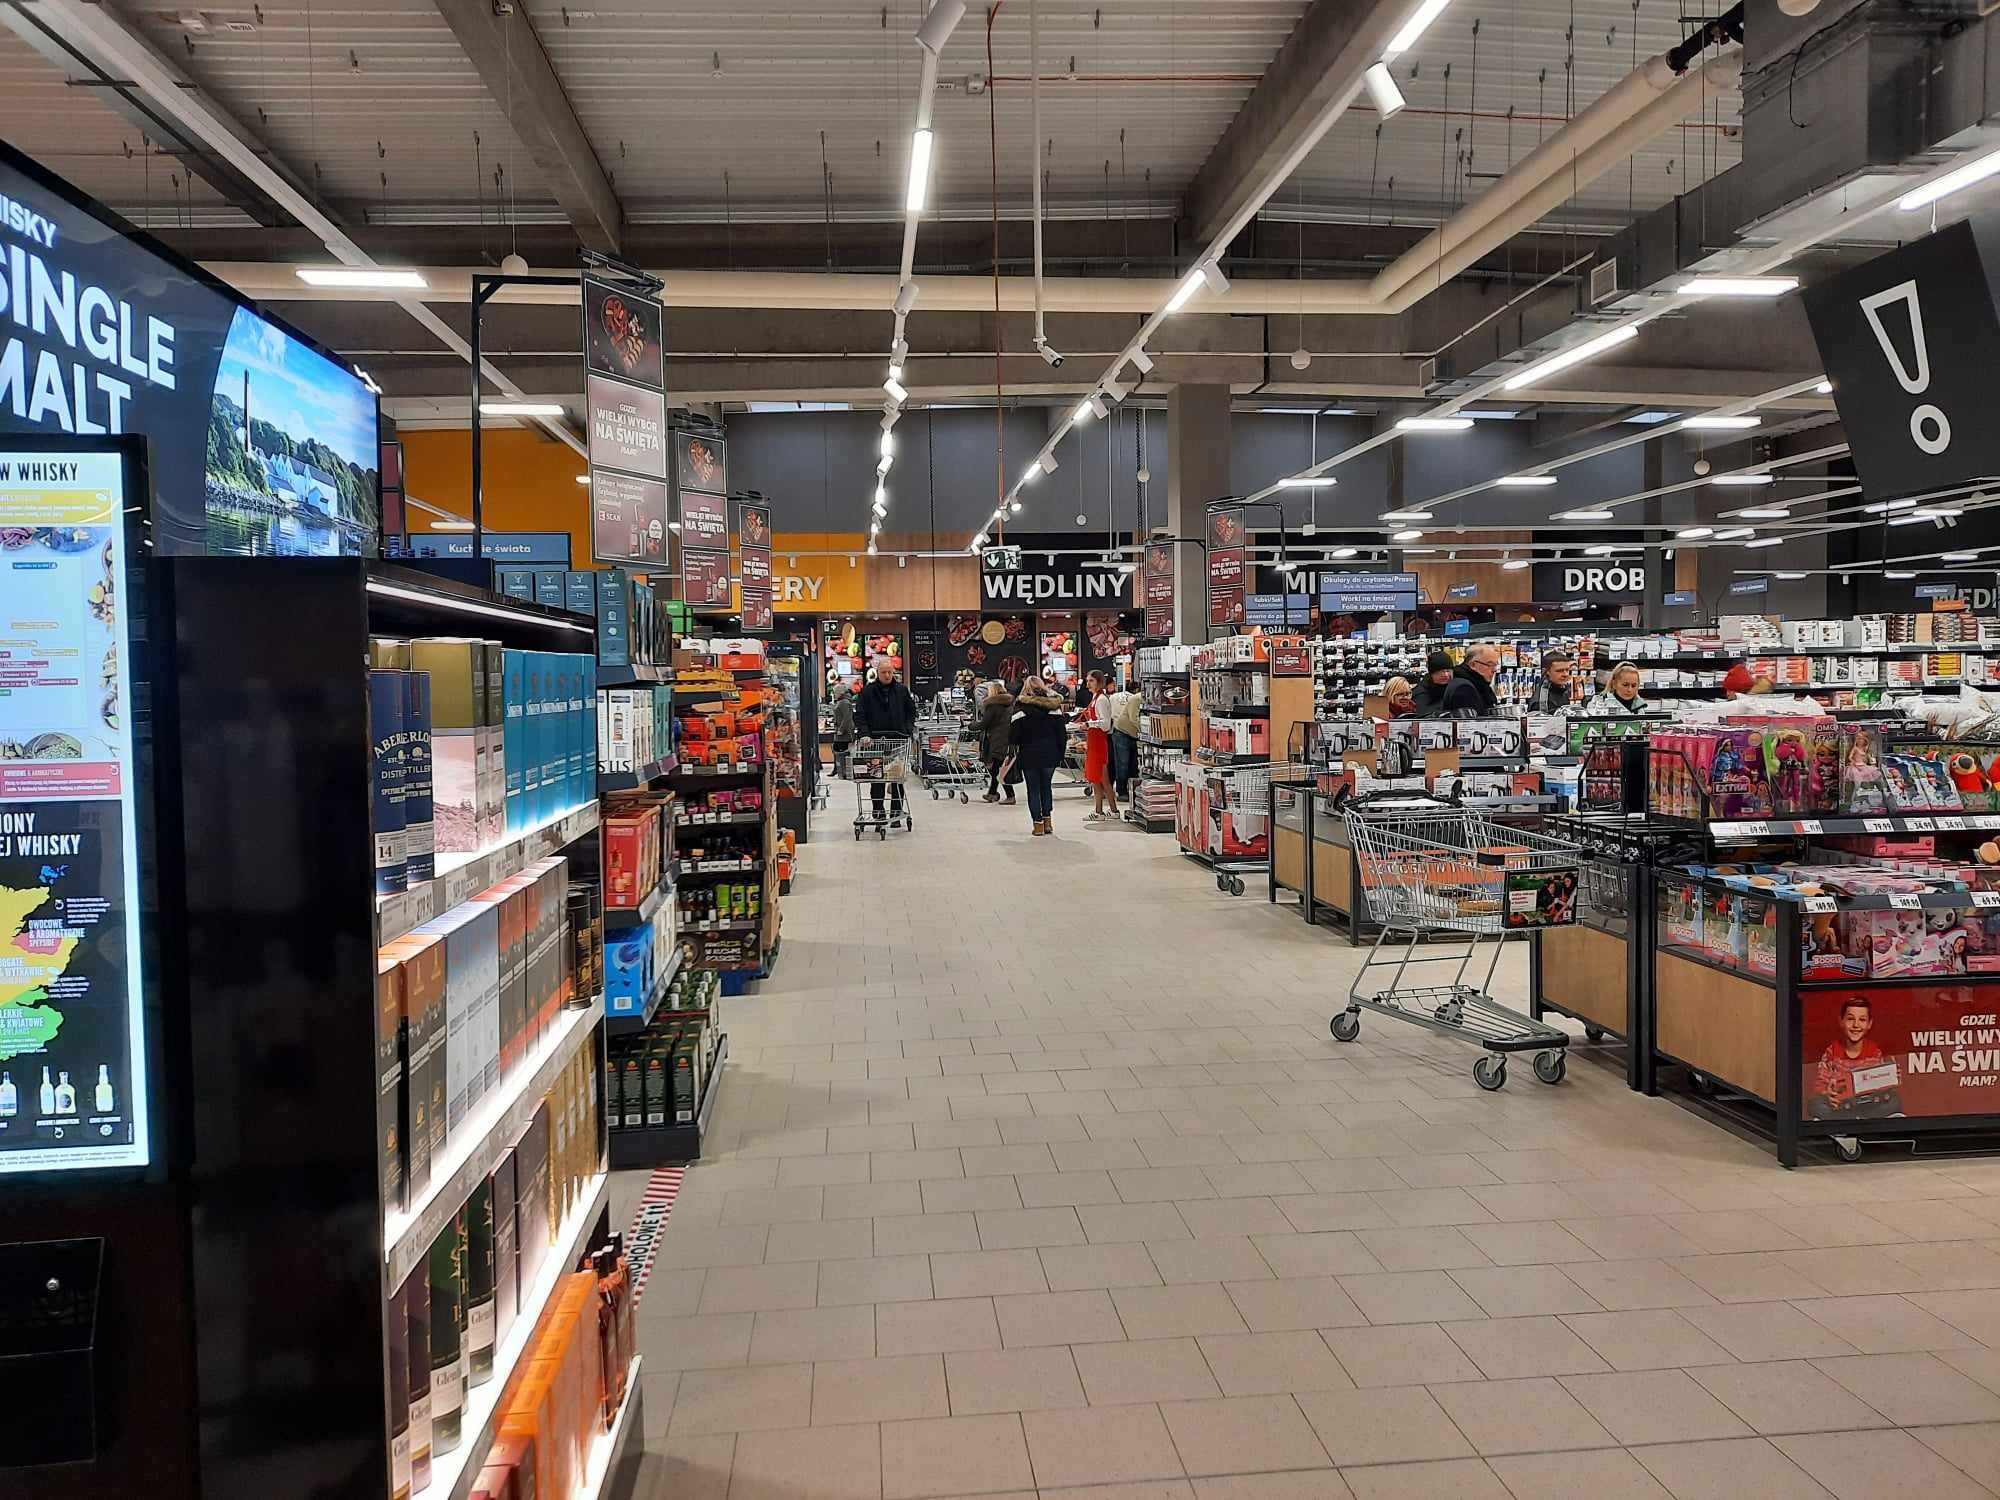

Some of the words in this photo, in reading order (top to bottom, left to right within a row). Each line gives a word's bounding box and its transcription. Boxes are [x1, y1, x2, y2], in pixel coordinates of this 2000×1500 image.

[0, 194, 56, 248] ISKY
[0, 243, 175, 390] INGLE
[596, 408, 627, 425] WIELKI
[595, 422, 614, 441] NA
[616, 424, 660, 451] ŚWIĘTA
[17, 463, 78, 481] WHISKY
[449, 543, 492, 553] Kuchie
[495, 541, 531, 553] świata
[1564, 559, 1645, 592] DRÓB
[983, 573, 1130, 604] WĘDLINY
[17, 834, 80, 856] WHISKY
[379, 845, 392, 858] 14
[1960, 1014, 1996, 1026] GDZIE
[1911, 1030, 1973, 1046] WIELKI
[1908, 1051, 1946, 1074] NA
[1959, 1075, 1998, 1088] MAM?
